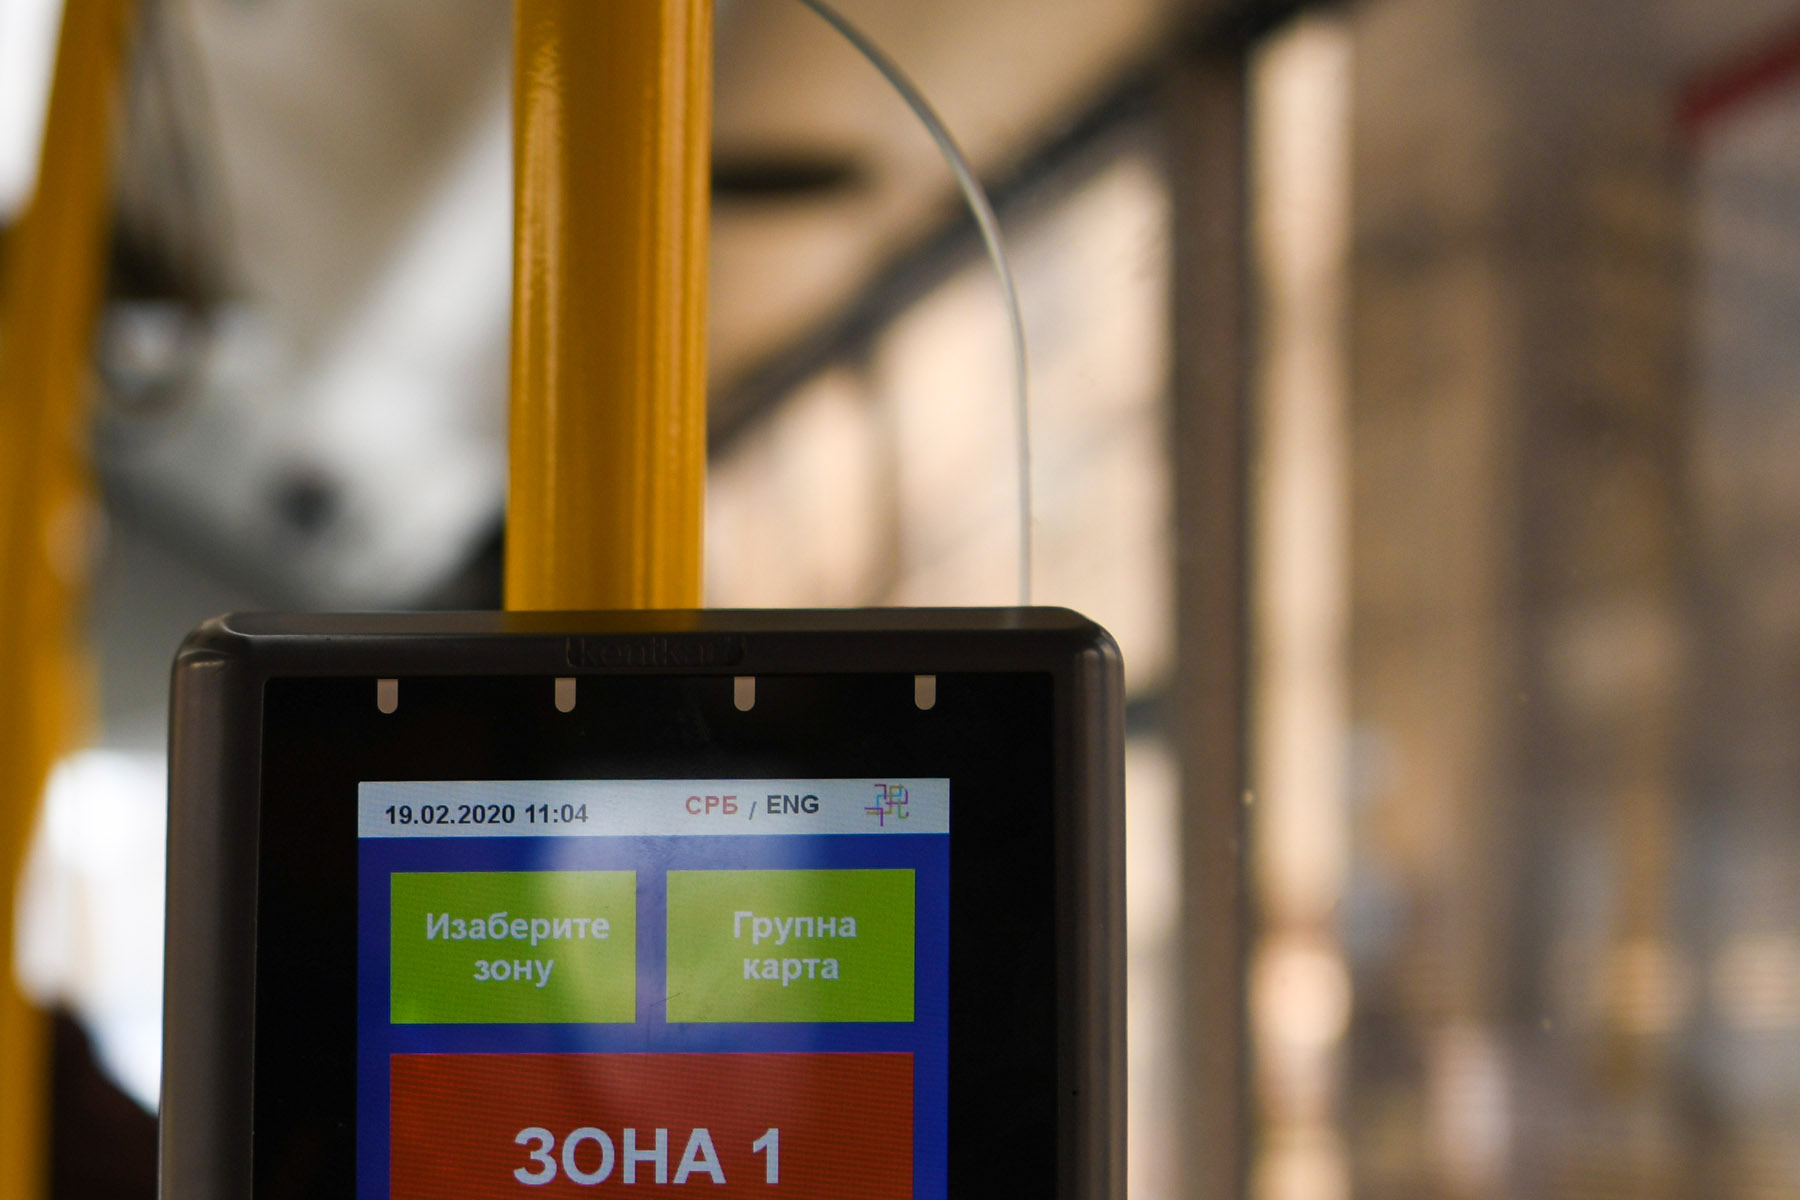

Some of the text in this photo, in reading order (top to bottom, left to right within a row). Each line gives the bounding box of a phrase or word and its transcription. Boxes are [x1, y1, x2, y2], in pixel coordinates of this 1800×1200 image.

[386, 803, 589, 825] 19.02.2020 11:04
[685, 794, 739, 815] СРБ
[766, 795, 820, 815] ENG
[426, 913, 610, 946] Изаберите
[733, 911, 857, 946] Групна
[473, 957, 554, 987] зону
[743, 956, 840, 987] карта
[513, 1127, 781, 1186] ЗОНА 1
